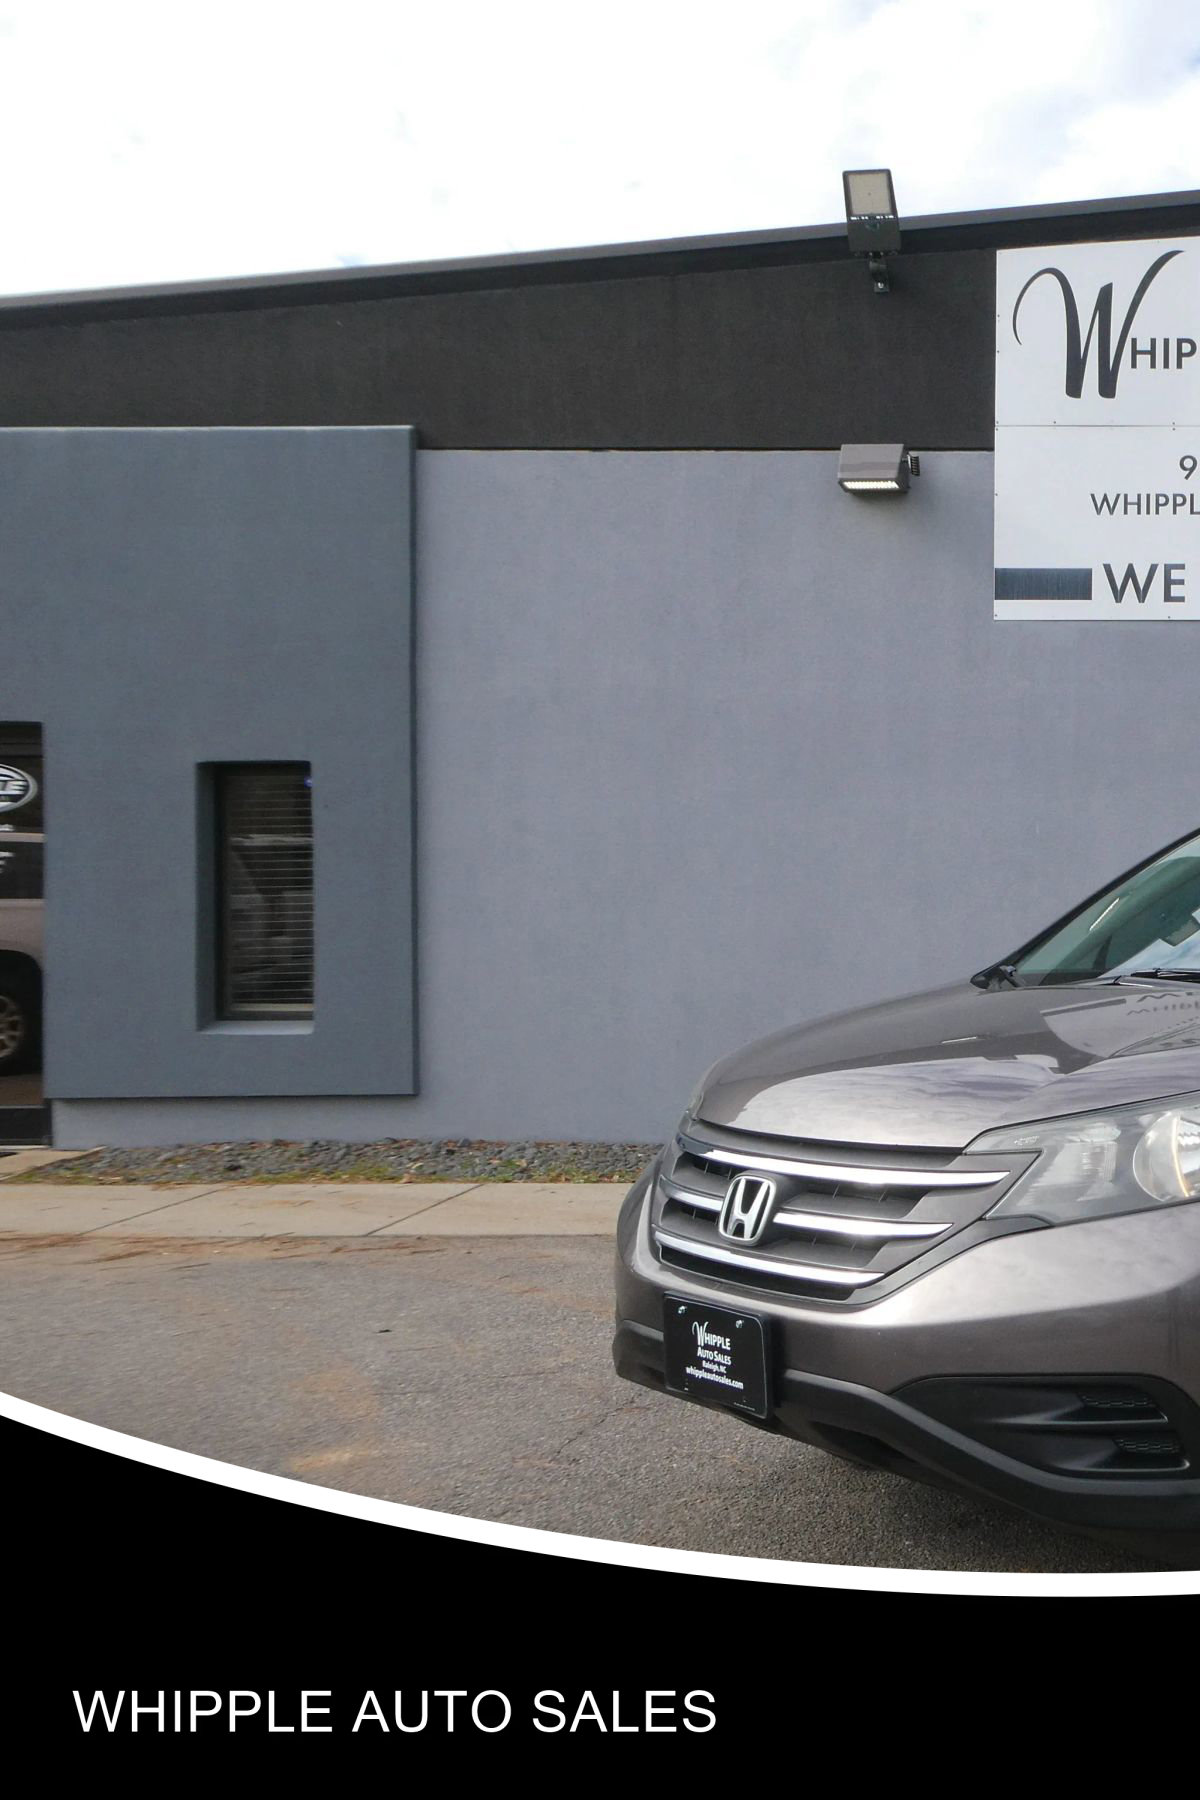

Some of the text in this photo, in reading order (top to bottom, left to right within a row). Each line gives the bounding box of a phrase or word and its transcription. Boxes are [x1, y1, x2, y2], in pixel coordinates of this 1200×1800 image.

[1102, 563, 1186, 604] WE
[692, 1321, 731, 1350] WHIPPLE
[697, 1346, 732, 1366] AUTO SALES
[685, 1365, 744, 1390] whippleautosales.com
